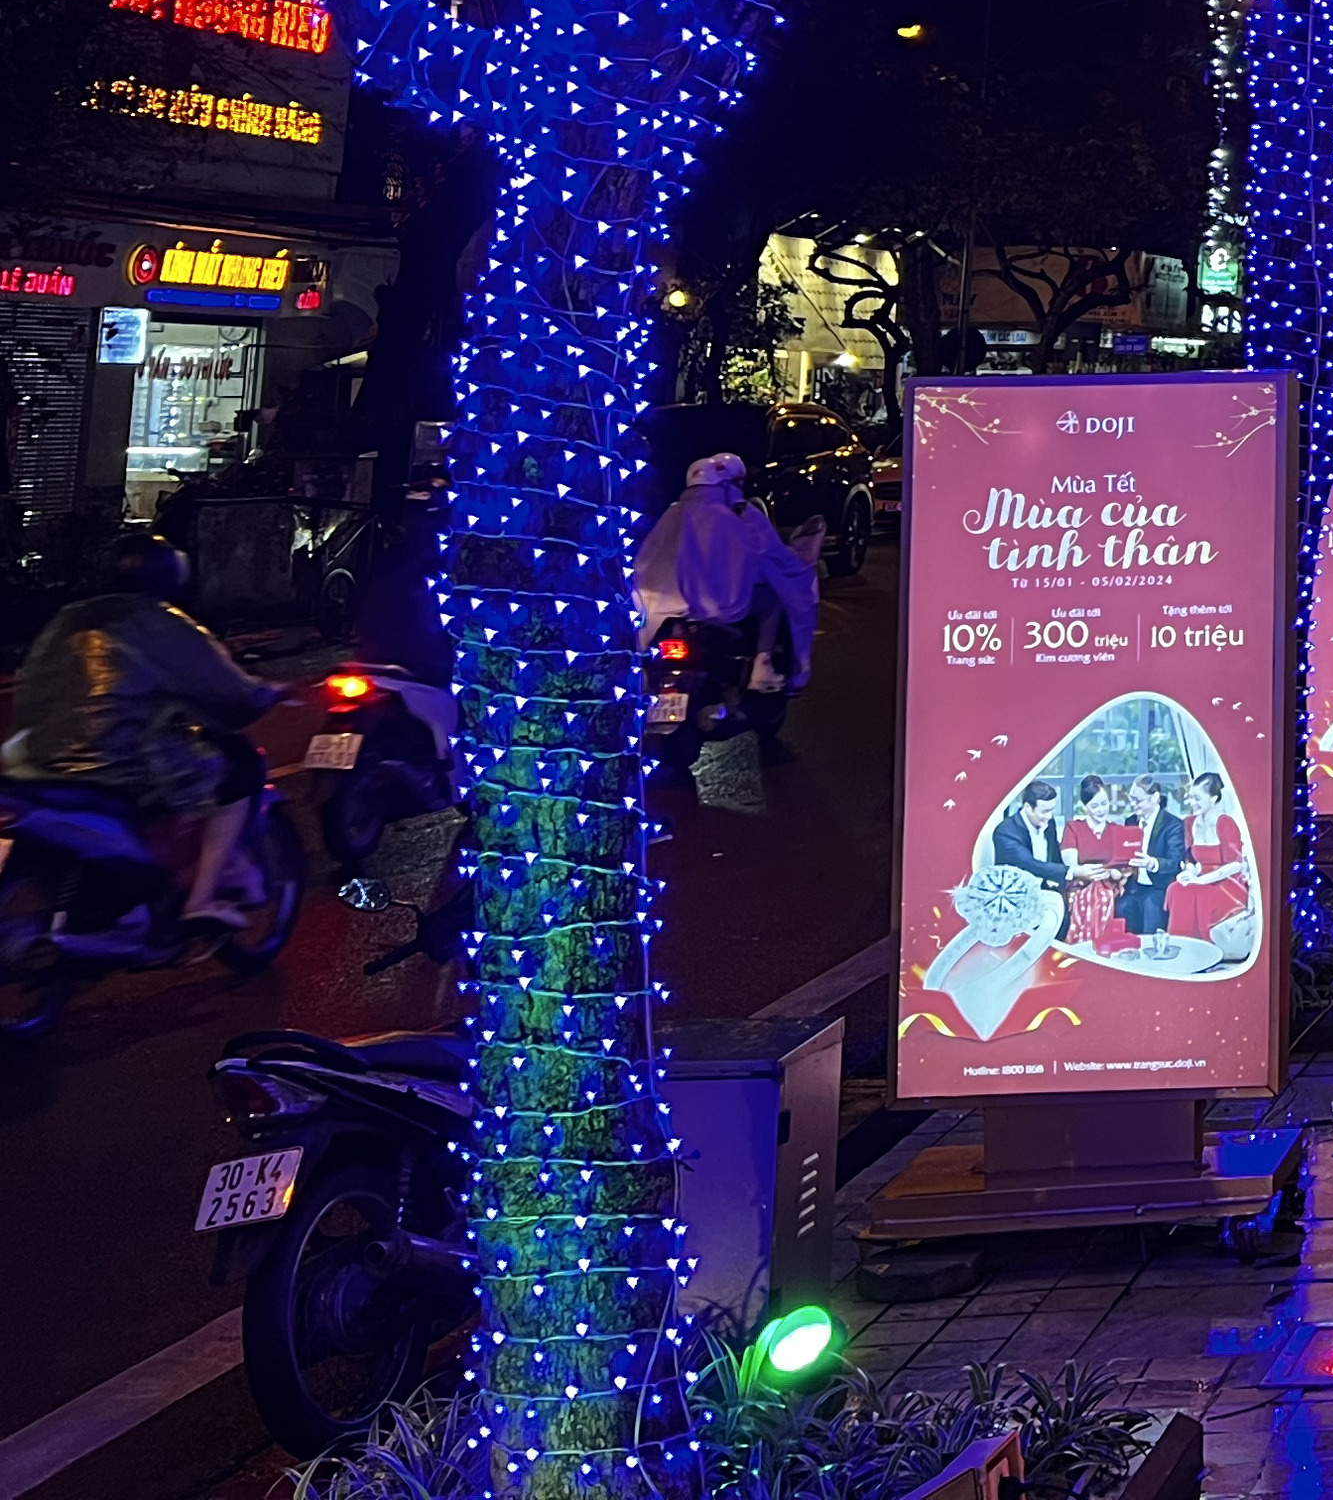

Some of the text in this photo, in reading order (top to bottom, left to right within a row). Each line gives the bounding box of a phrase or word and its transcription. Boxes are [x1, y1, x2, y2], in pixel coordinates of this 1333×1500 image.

[1085, 416, 1135, 439] DOJI
[1051, 471, 1136, 494] Mùa Tết
[962, 487, 1188, 534] Mùa của
[983, 528, 1218, 571] tình thân
[1035, 577, 1072, 589] 15/01
[1092, 575, 1173, 587] 05/02/2024
[943, 623, 1002, 653] 10%
[1023, 620, 1128, 650] 300 triệu
[1150, 624, 1244, 652] 10 triệu
[946, 655, 976, 667] Trang
[214, 1153, 286, 1193] 30-K4
[205, 1187, 277, 1228] 2563
